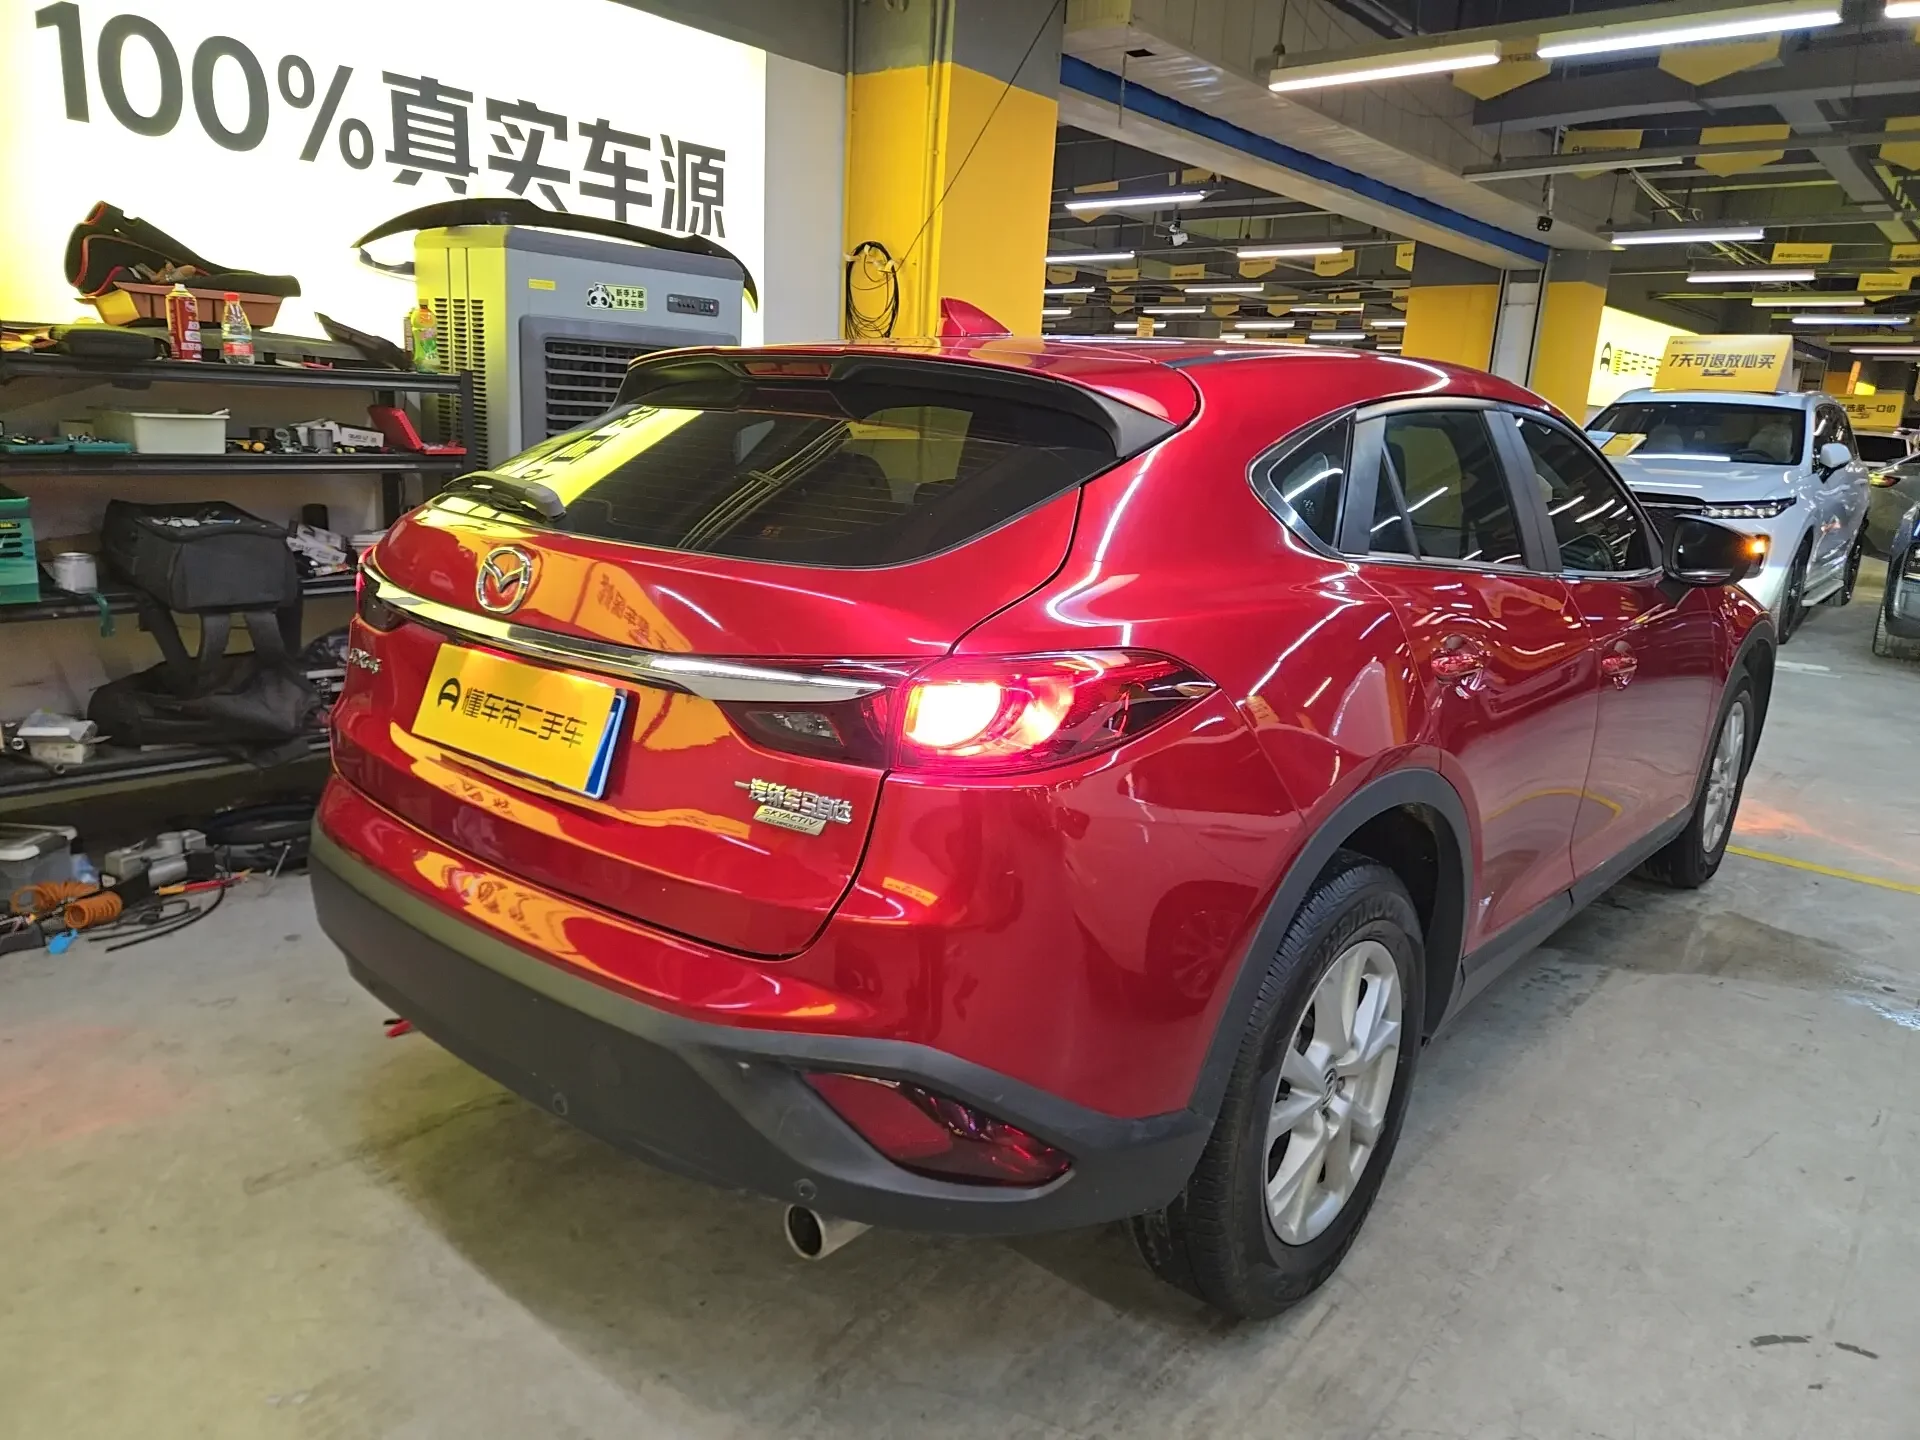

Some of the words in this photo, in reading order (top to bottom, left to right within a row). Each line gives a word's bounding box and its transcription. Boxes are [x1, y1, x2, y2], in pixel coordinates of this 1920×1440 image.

[35, 1, 727, 239] 100%真实车源
[1668, 353, 1776, 369] 7天可退放心买
[1841, 403, 1896, 414] 选品一口价
[461, 687, 587, 749] 懂车帝二手车
[763, 808, 818, 826] SKYACTIV
[764, 817, 809, 832] TECHNOLOGY
